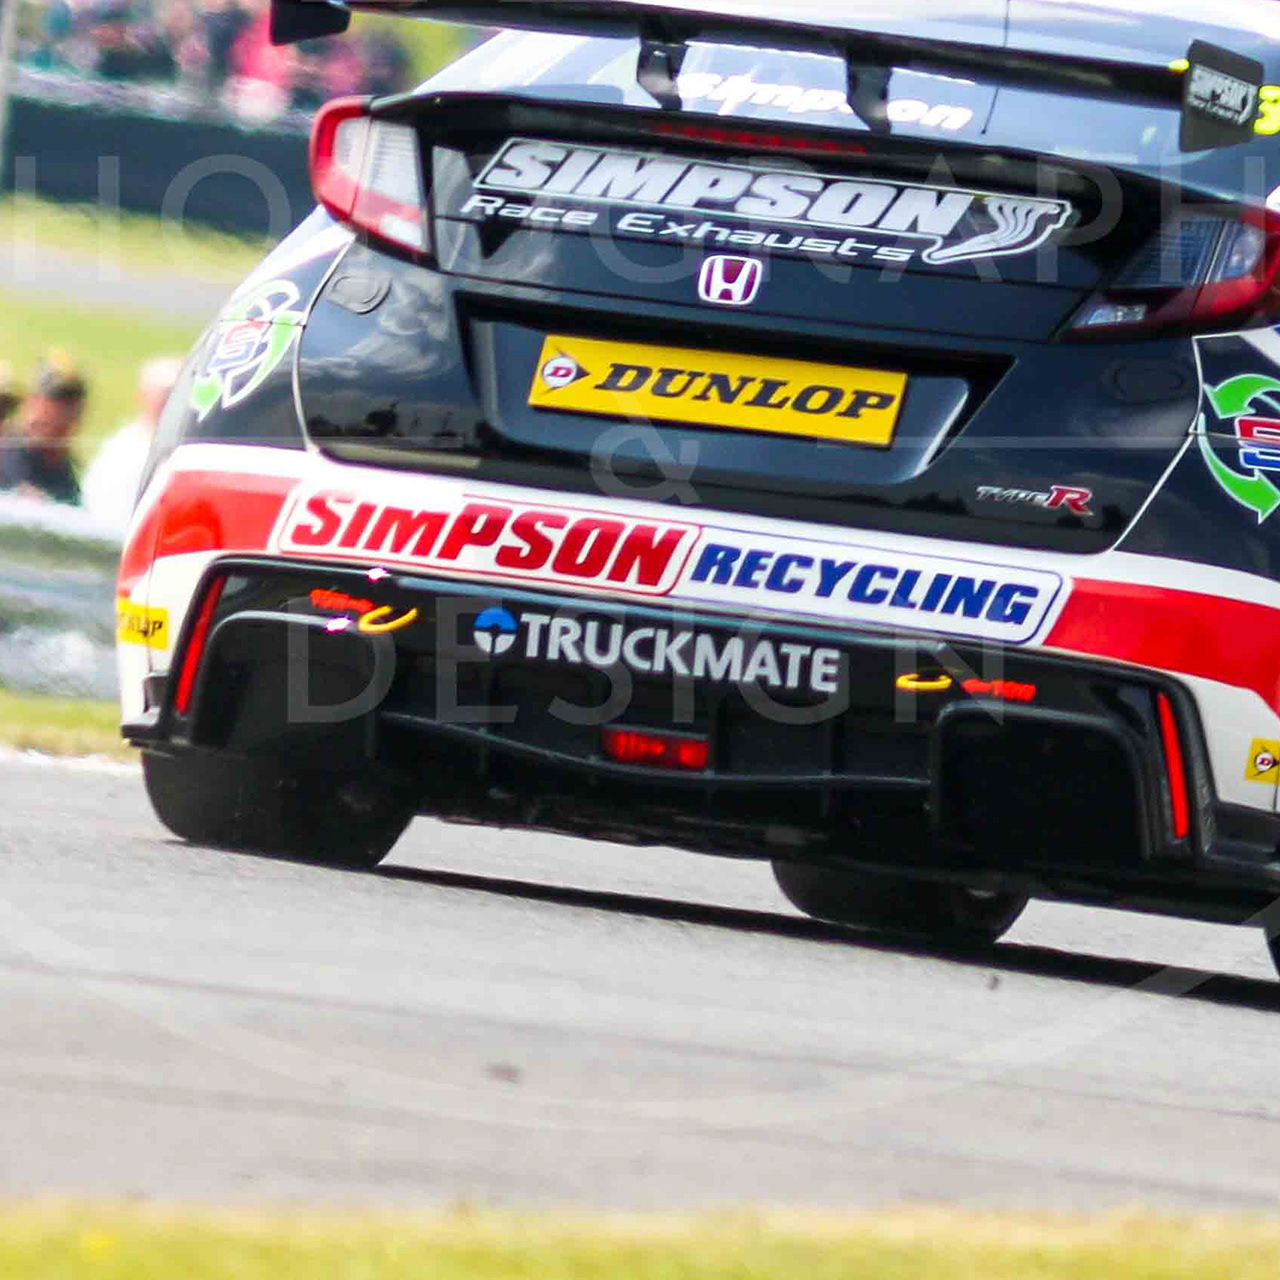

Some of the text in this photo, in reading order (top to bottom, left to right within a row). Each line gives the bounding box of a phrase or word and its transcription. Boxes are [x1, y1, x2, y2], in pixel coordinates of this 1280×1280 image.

[676, 71, 974, 131] Simpon
[461, 194, 915, 263] Race Exhausts
[485, 145, 975, 236] SIMPSON
[595, 363, 895, 419] DUNLOP
[693, 542, 1041, 627] RECYCLING
[520, 611, 840, 694] TRUCKMATE
